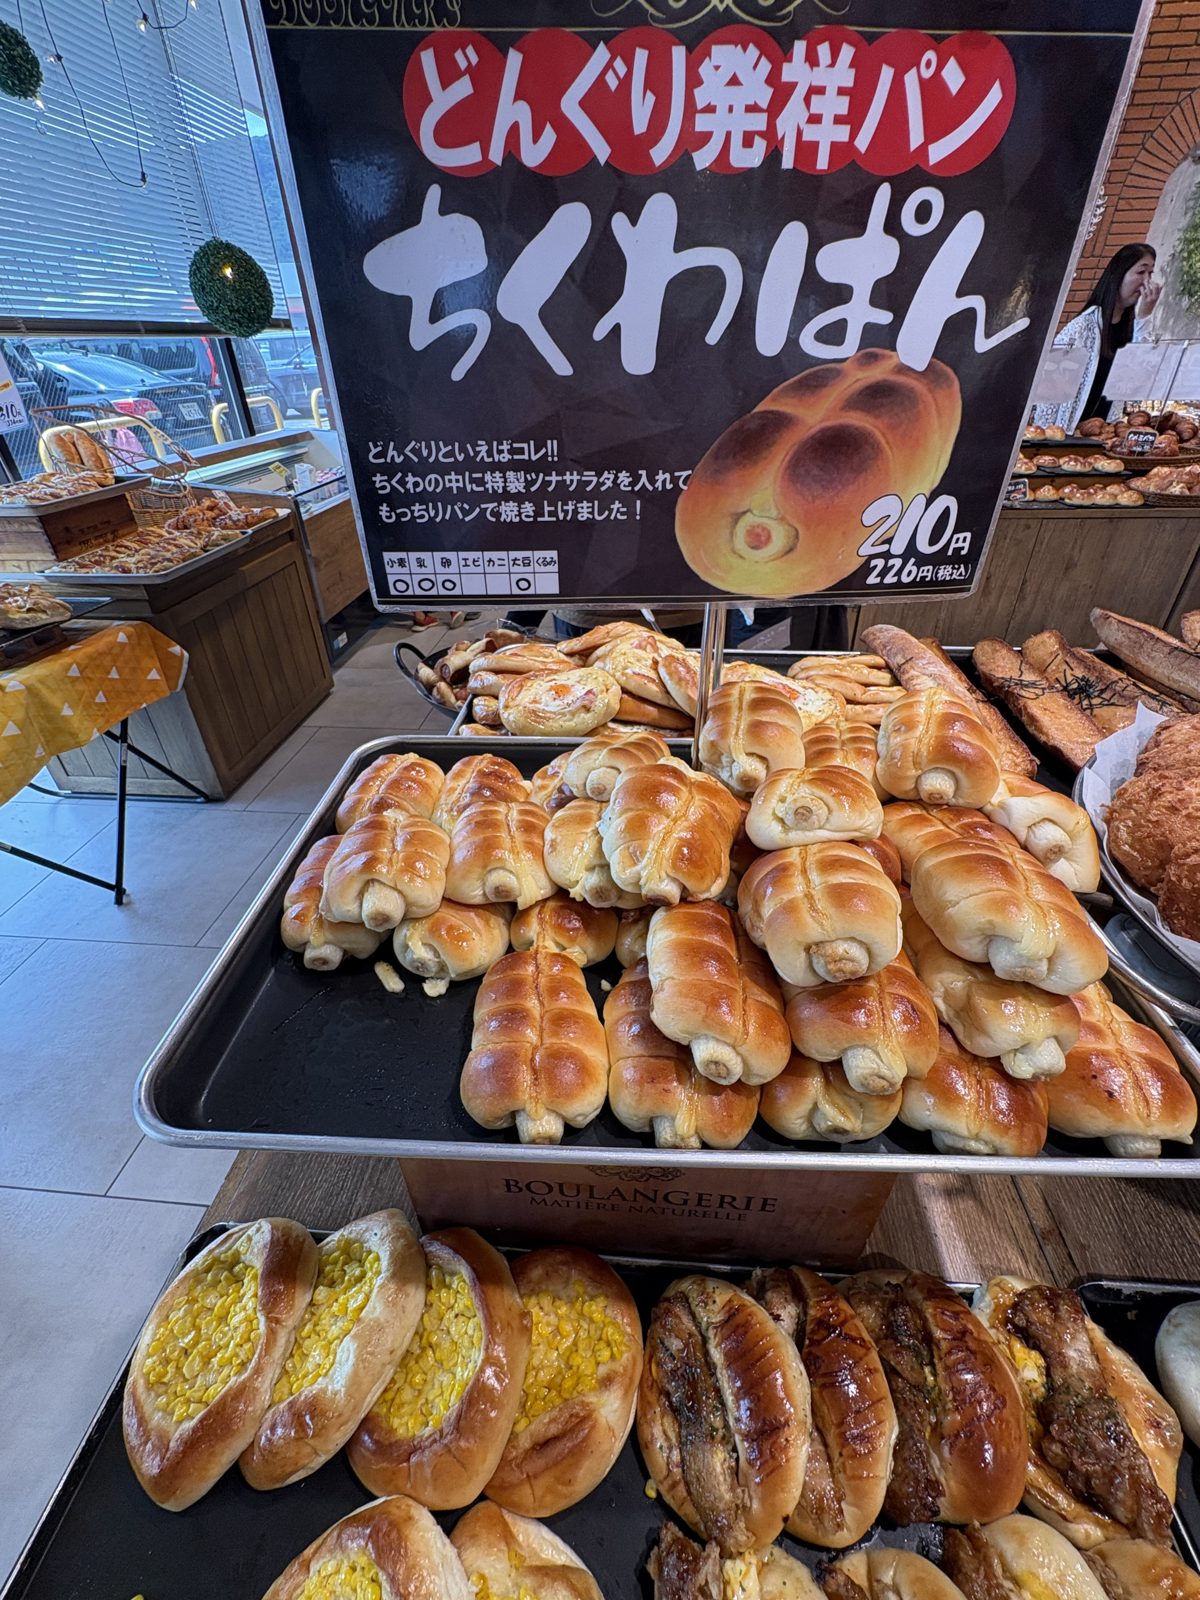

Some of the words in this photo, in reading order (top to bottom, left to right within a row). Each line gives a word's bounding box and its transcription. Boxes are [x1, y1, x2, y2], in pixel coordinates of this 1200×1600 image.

[419, 39, 1003, 171] どんぐり発祥パン
[362, 181, 1031, 382] ちくわぱん
[372, 469, 693, 495] ちくわの中に特製ツナサラダを入れて
[386, 556, 408, 569] 小麦
[415, 556, 428, 569] 乳
[440, 556, 452, 569] 卵
[462, 556, 481, 568] エビ
[486, 557, 507, 568] カニ
[511, 556, 532, 568] 大豆
[535, 556, 557, 568] くるみ
[865, 557, 972, 585] 226円(税込)
[503, 1177, 778, 1214] BOULANGERIE
[628, 1205, 748, 1222] NATURELLE
